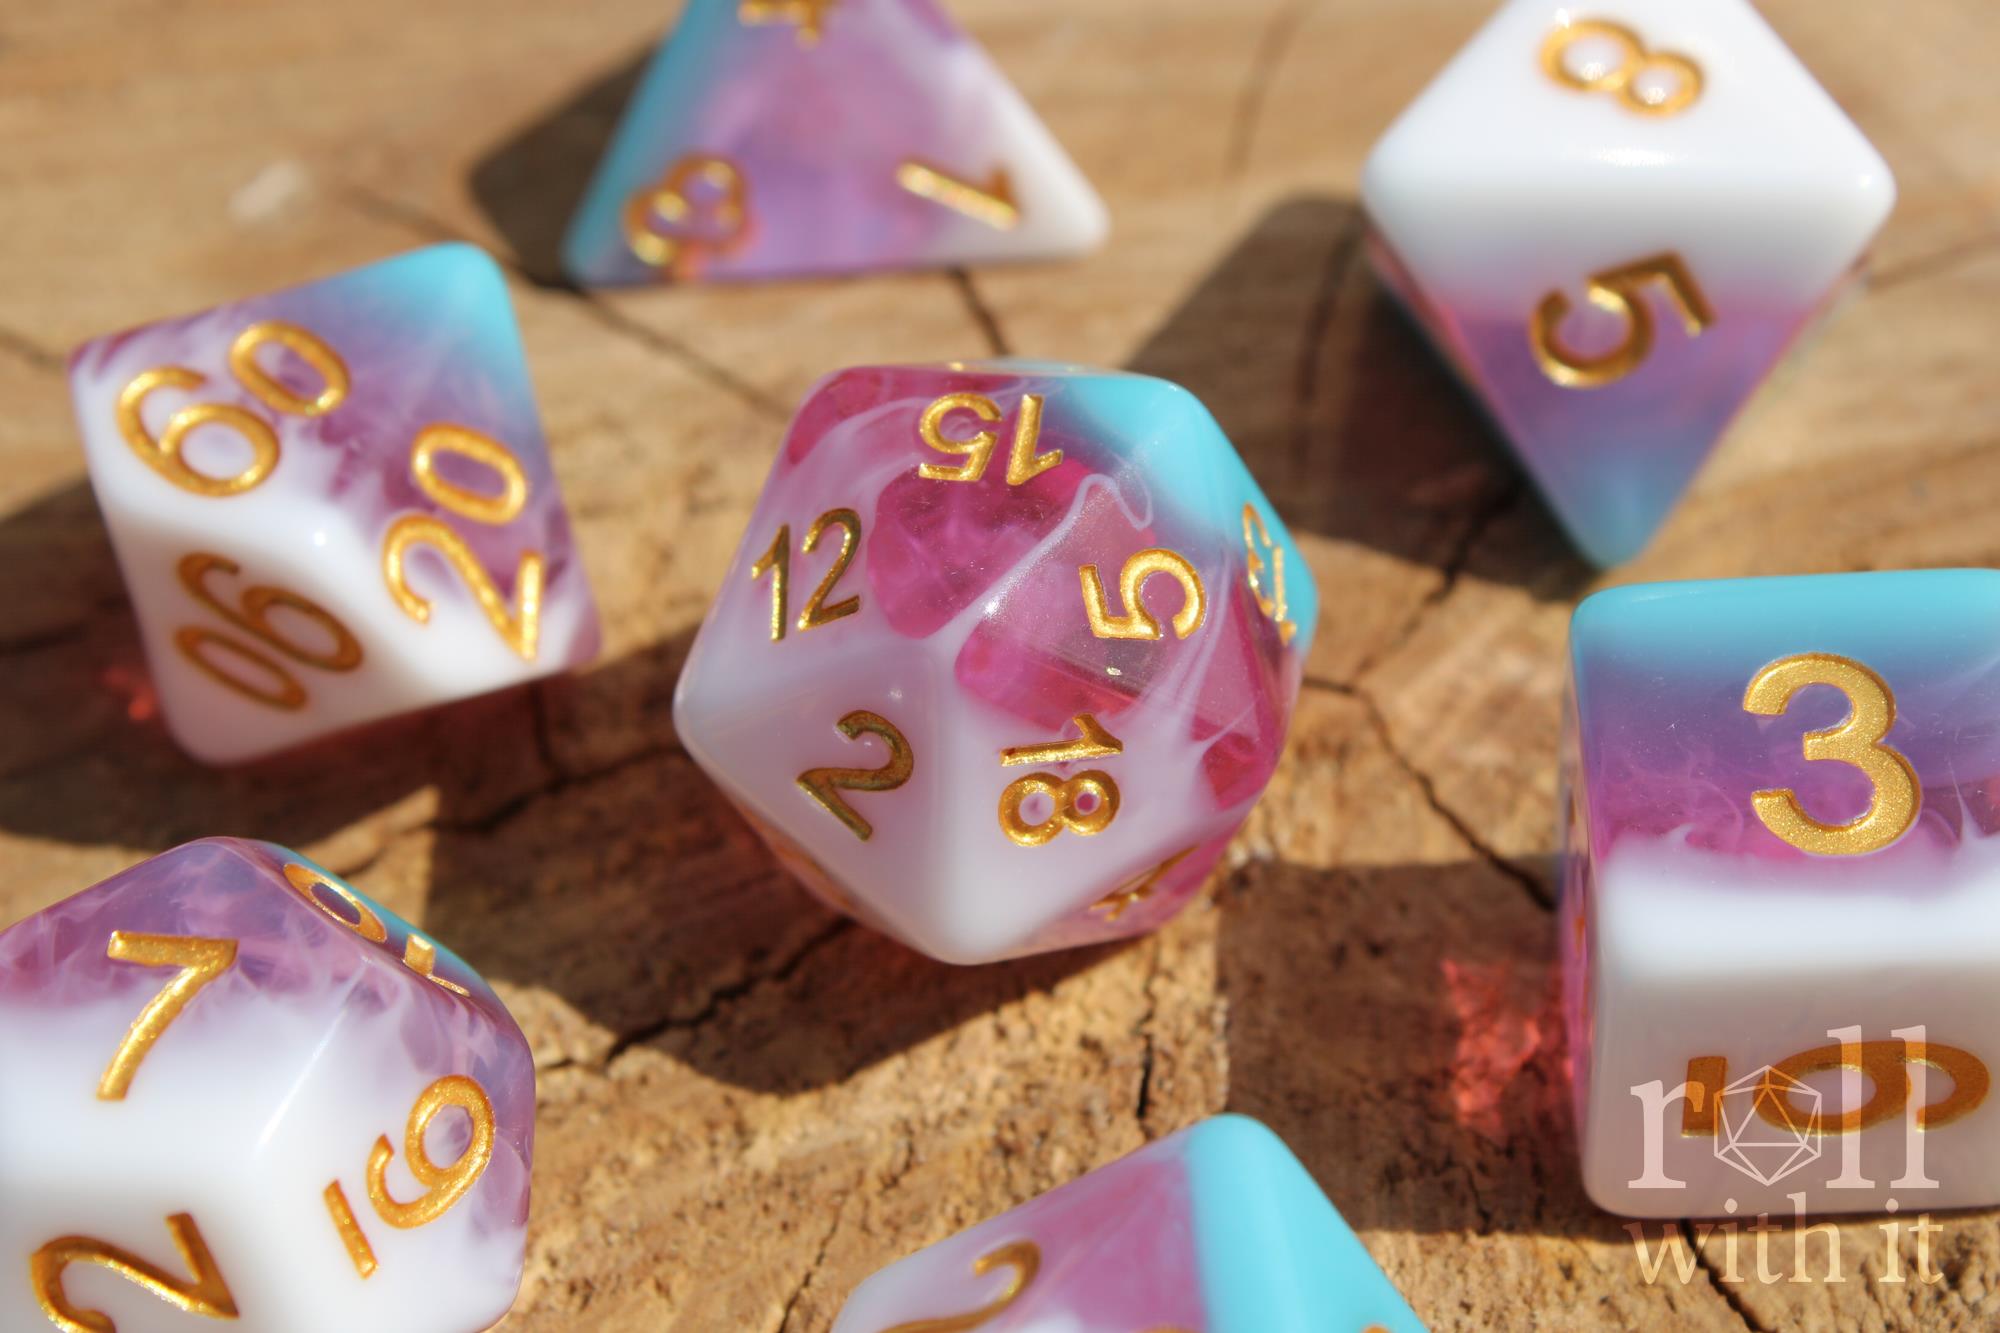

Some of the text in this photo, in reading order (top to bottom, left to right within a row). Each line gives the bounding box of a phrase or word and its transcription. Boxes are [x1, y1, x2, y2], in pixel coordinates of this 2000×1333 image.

[1537, 18, 1706, 120] 8
[1527, 250, 1717, 390] 5
[116, 320, 350, 497] 60
[917, 392, 1064, 486] 15
[381, 422, 529, 662] 20
[751, 507, 862, 642] 12
[1078, 548, 1207, 640] 5
[796, 710, 914, 842] 2
[998, 712, 1124, 847] 18
[1743, 651, 1923, 857] 3
[96, 929, 240, 1102] 7
[30, 1211, 241, 1333] 2
